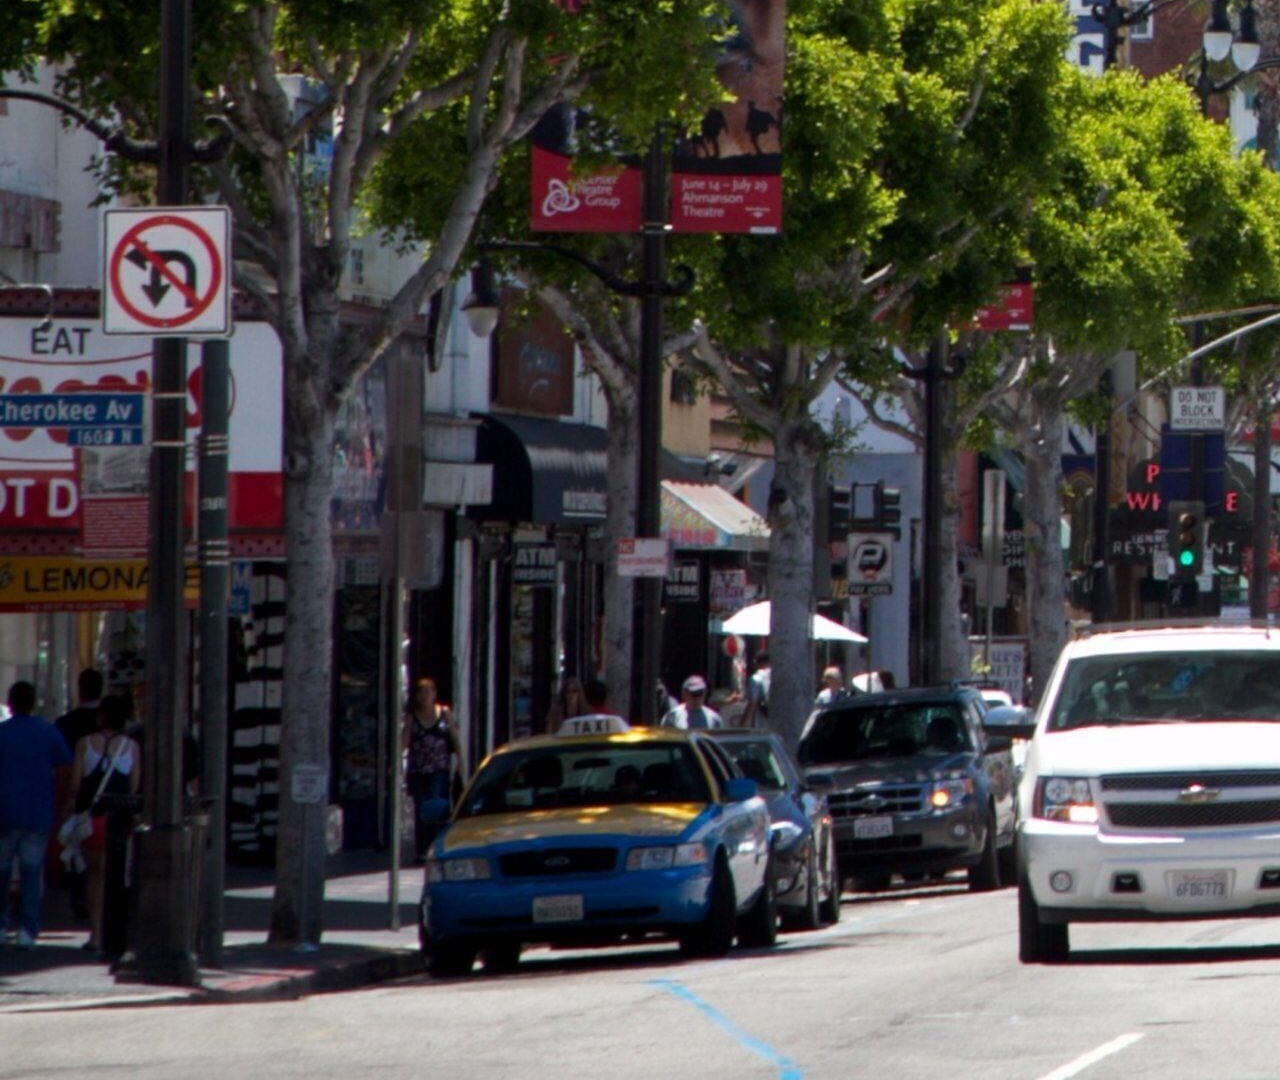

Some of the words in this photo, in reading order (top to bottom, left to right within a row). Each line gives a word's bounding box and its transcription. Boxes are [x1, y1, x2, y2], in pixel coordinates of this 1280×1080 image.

[682, 179, 706, 192] June
[732, 179, 753, 192] July
[682, 192, 743, 204] Ahmanson
[682, 206, 725, 218] Theatre
[31, 327, 91, 354] EAT
[1178, 390, 1192, 402] DO
[1197, 390, 1217, 402] NOT
[106, 401, 132, 420] Av
[1181, 404, 1214, 416] BLOCK
[516, 547, 556, 566] ATM
[514, 569, 556, 581] INSIDE
[574, 719, 610, 734] TAXI
